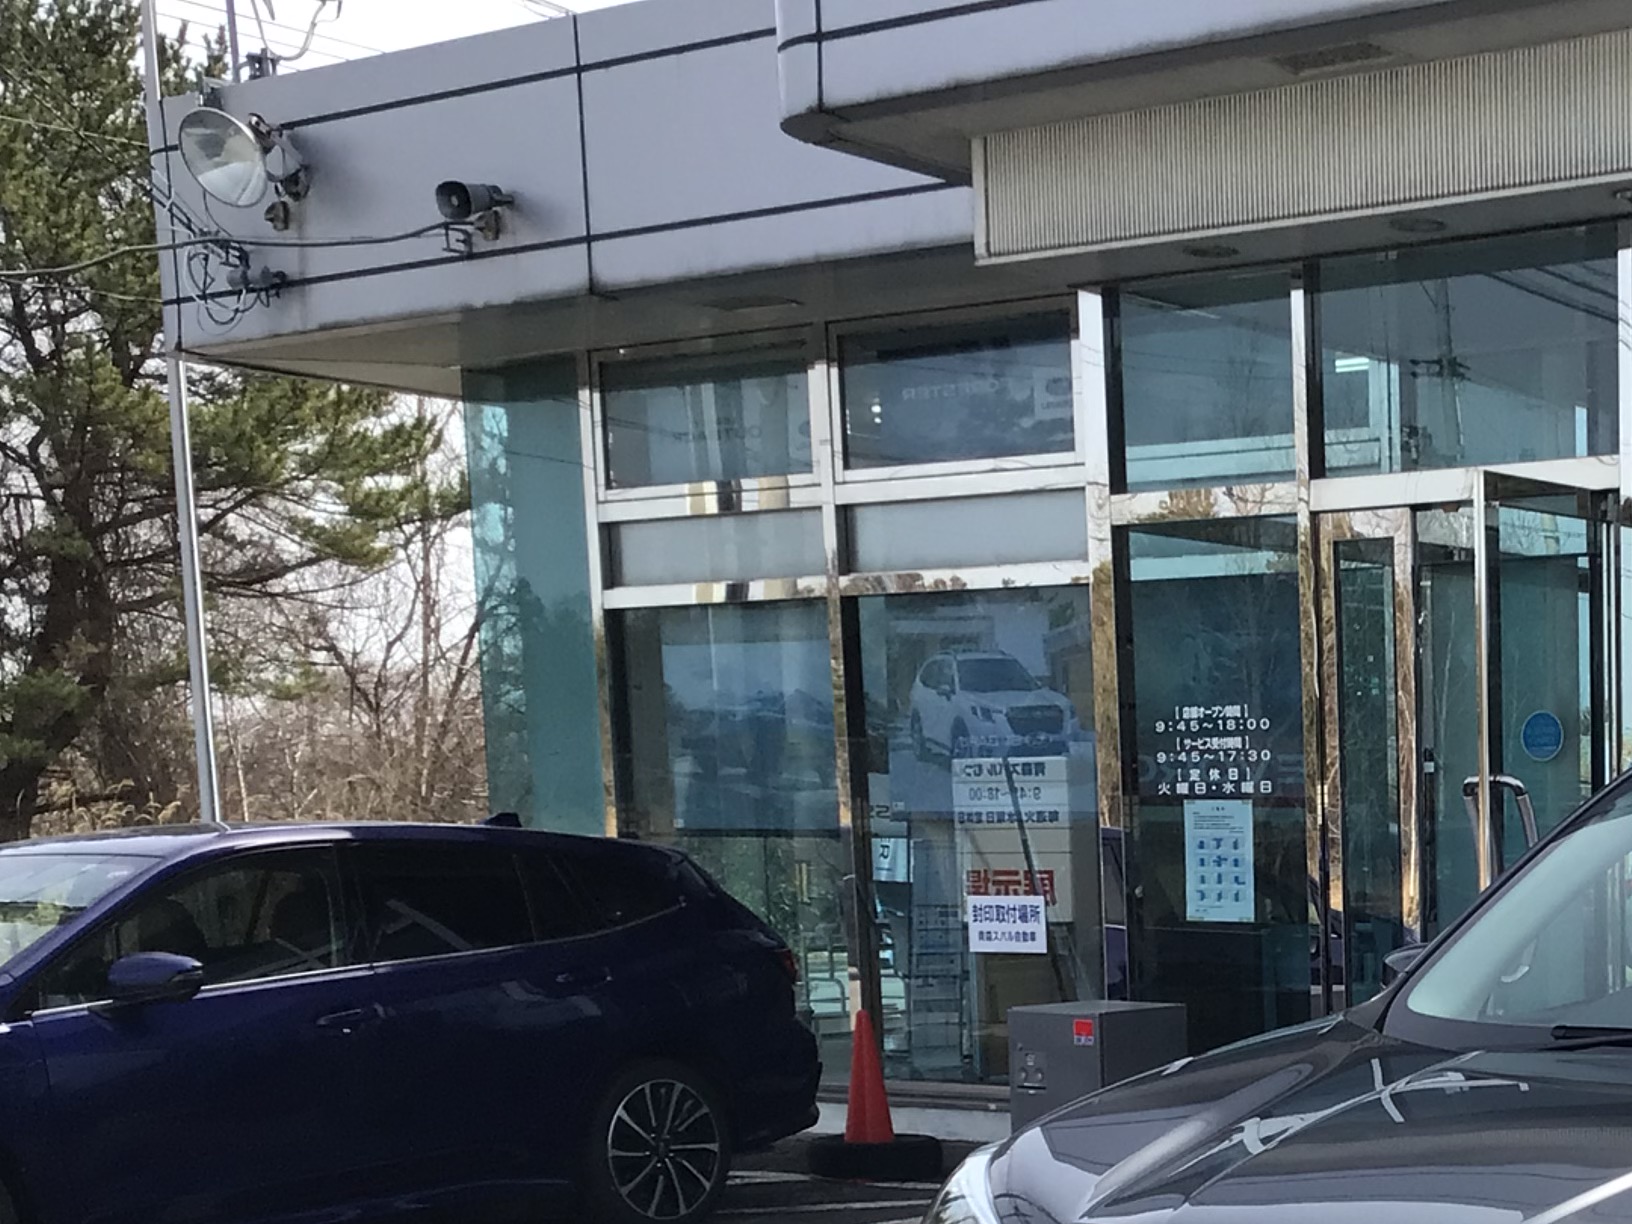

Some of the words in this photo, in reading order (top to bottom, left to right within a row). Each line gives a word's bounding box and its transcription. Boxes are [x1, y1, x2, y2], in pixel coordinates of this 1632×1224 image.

[972, 904, 1040, 924] 封印取付場所
